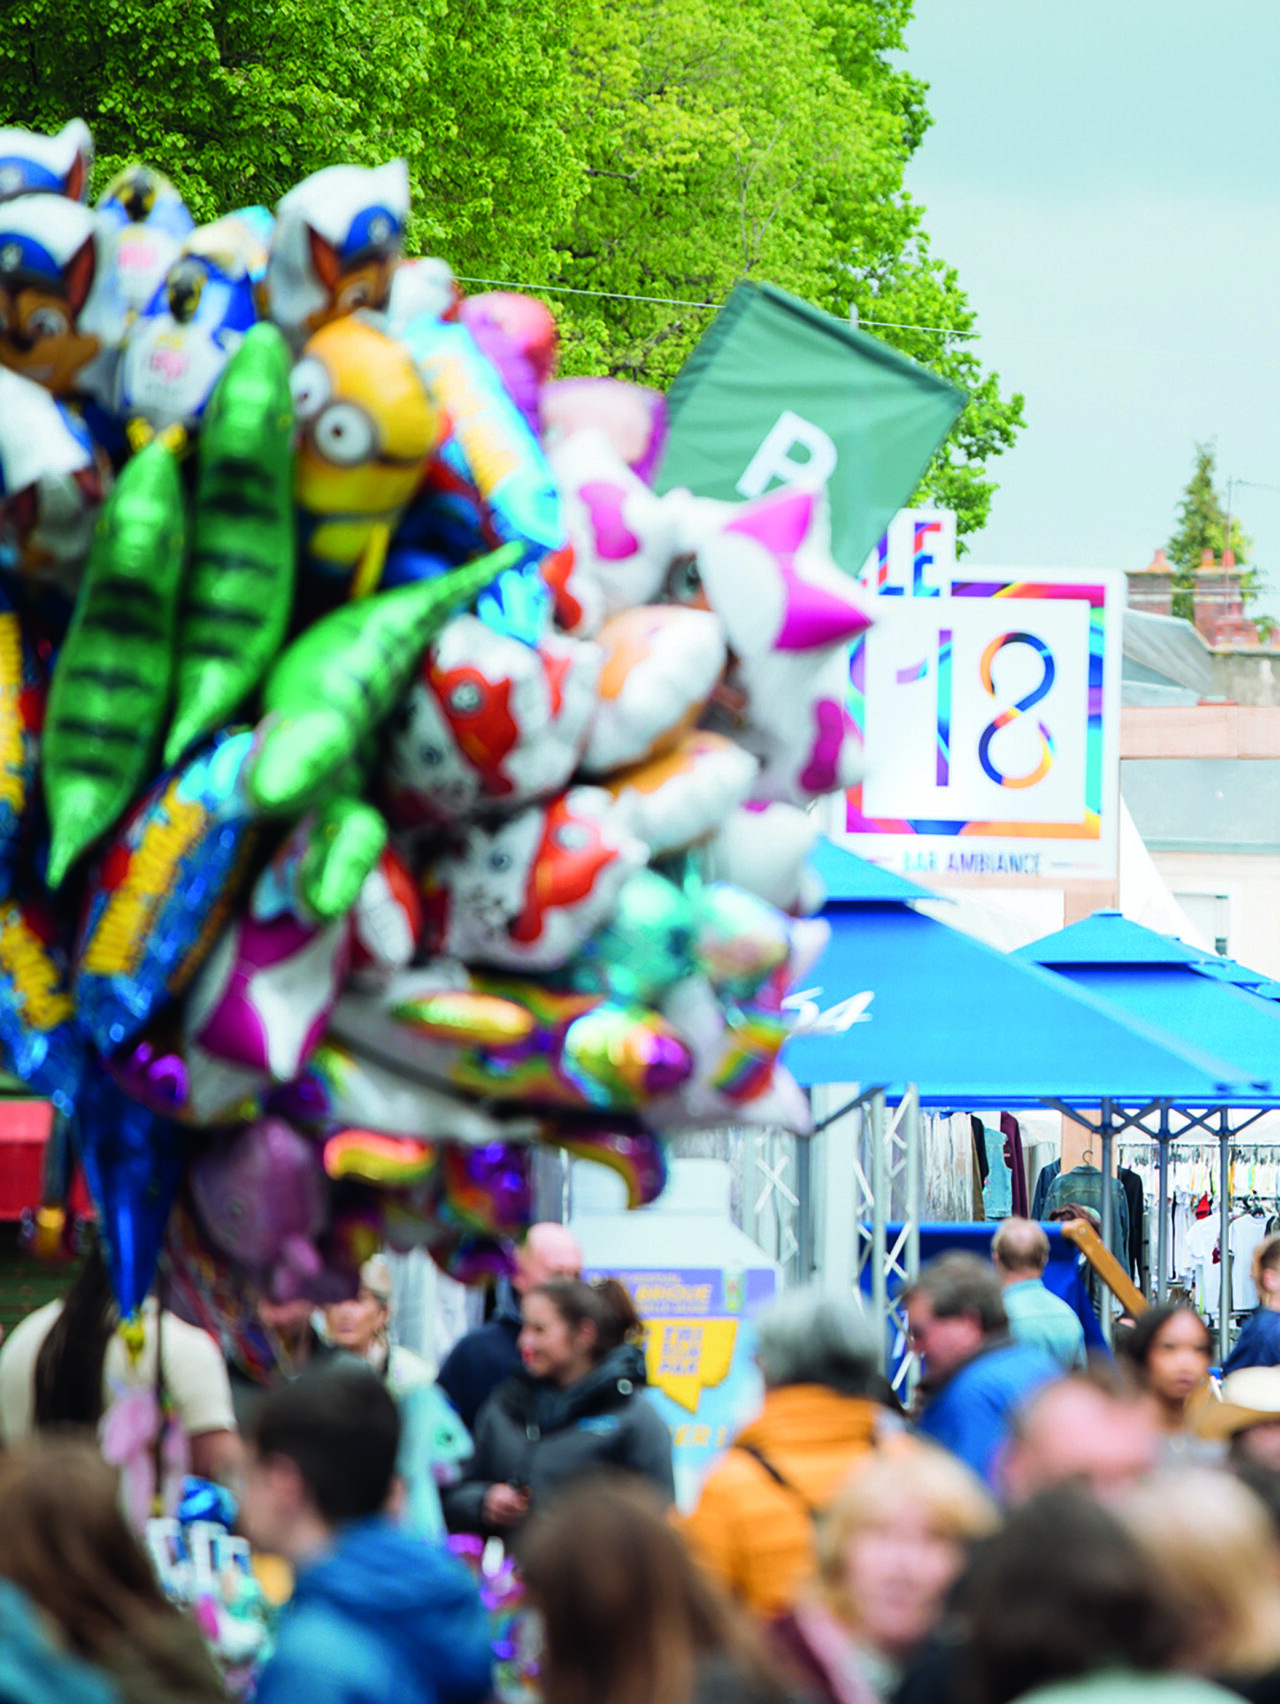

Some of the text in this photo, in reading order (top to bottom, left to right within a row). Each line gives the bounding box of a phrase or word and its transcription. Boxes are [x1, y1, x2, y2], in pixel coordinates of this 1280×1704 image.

[877, 522, 942, 597] LE
[896, 629, 1056, 790] 18
[946, 851, 1042, 876] AMBIANCE
